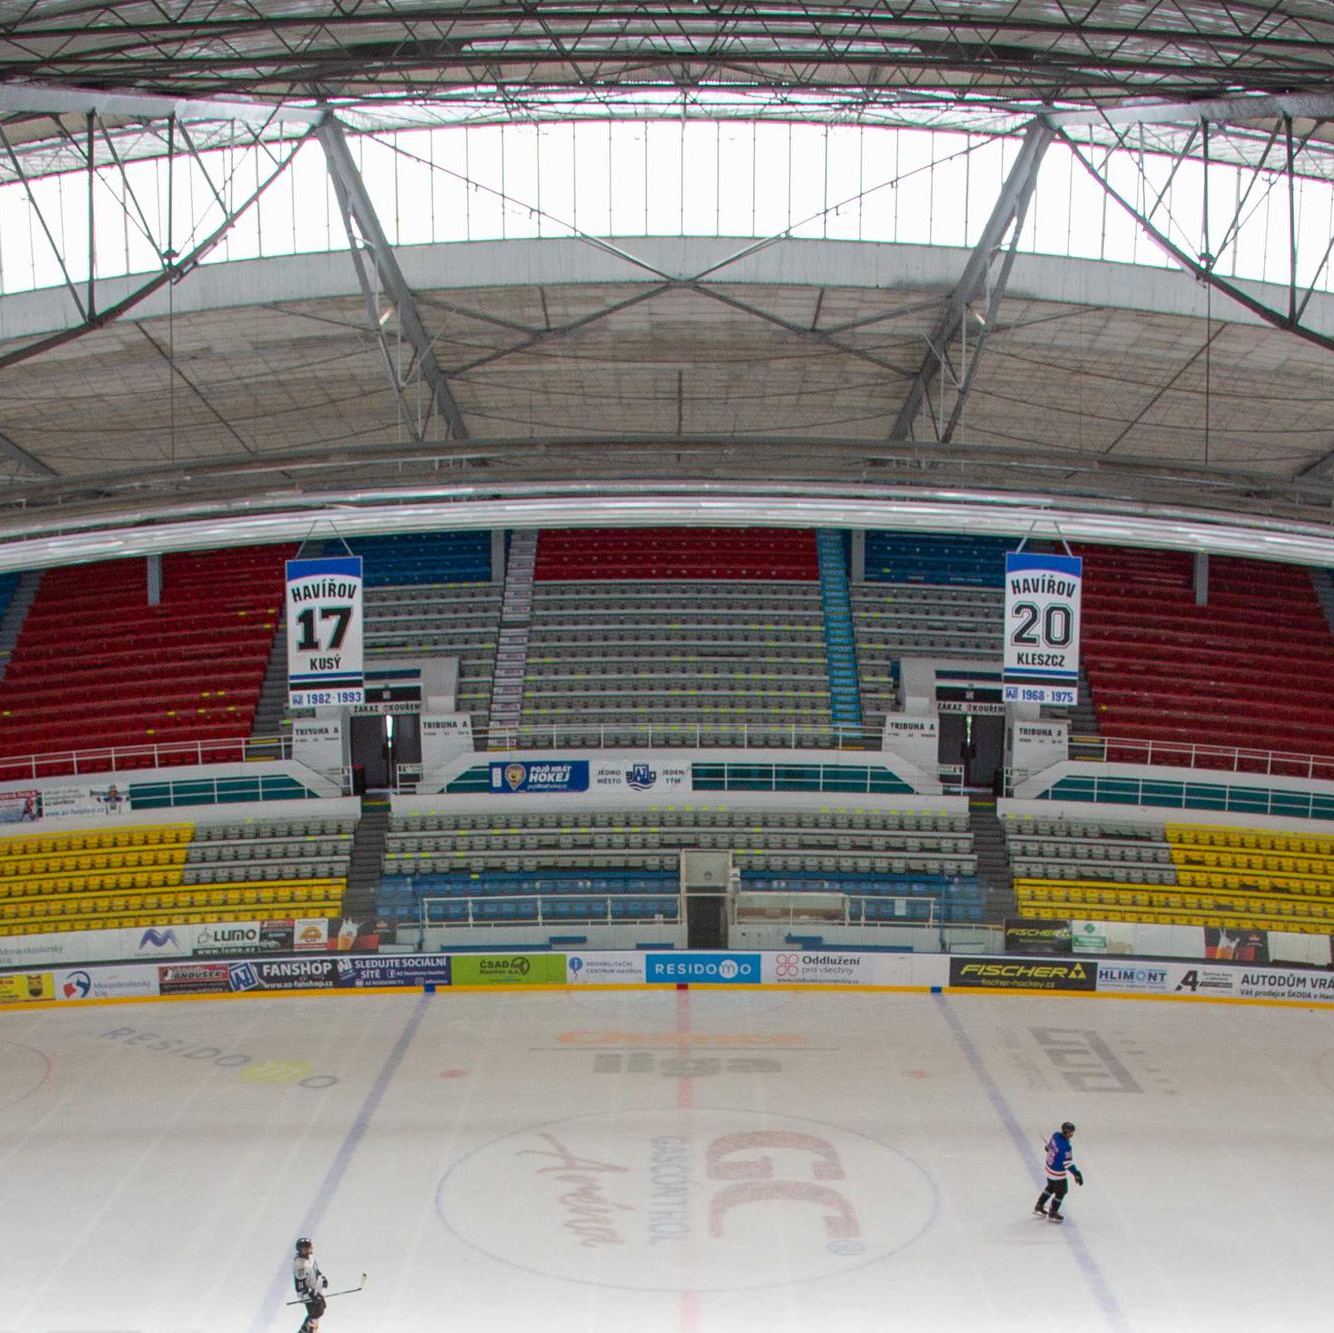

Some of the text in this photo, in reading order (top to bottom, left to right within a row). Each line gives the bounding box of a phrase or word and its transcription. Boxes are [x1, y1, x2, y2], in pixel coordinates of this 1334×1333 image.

[291, 578, 357, 602] HAVÍŘOV
[1011, 574, 1076, 598] HAVÍŘOV
[296, 604, 354, 652] 17
[1011, 601, 1074, 649] 20
[310, 655, 341, 671] KUSÝ
[1017, 652, 1065, 668] KLESZCZ
[529, 772, 570, 783] HOKEJ
[214, 929, 256, 942] LUMO
[1007, 928, 1062, 937] FISCHER
[355, 957, 447, 970] SLEDUJTE SOCIÁLNÍ
[479, 959, 509, 969] ČSAD
[802, 954, 860, 967] Oddlužení
[263, 961, 332, 977] FANSHOP
[361, 968, 381, 979] SÍTĚ
[803, 966, 854, 976] pro všechny
[960, 963, 1067, 978] FISCHER
[1242, 973, 1307, 989] AUTODŮM
[1240, 988, 1252, 996] Váš
[1253, 989, 1286, 1000] prodejce
